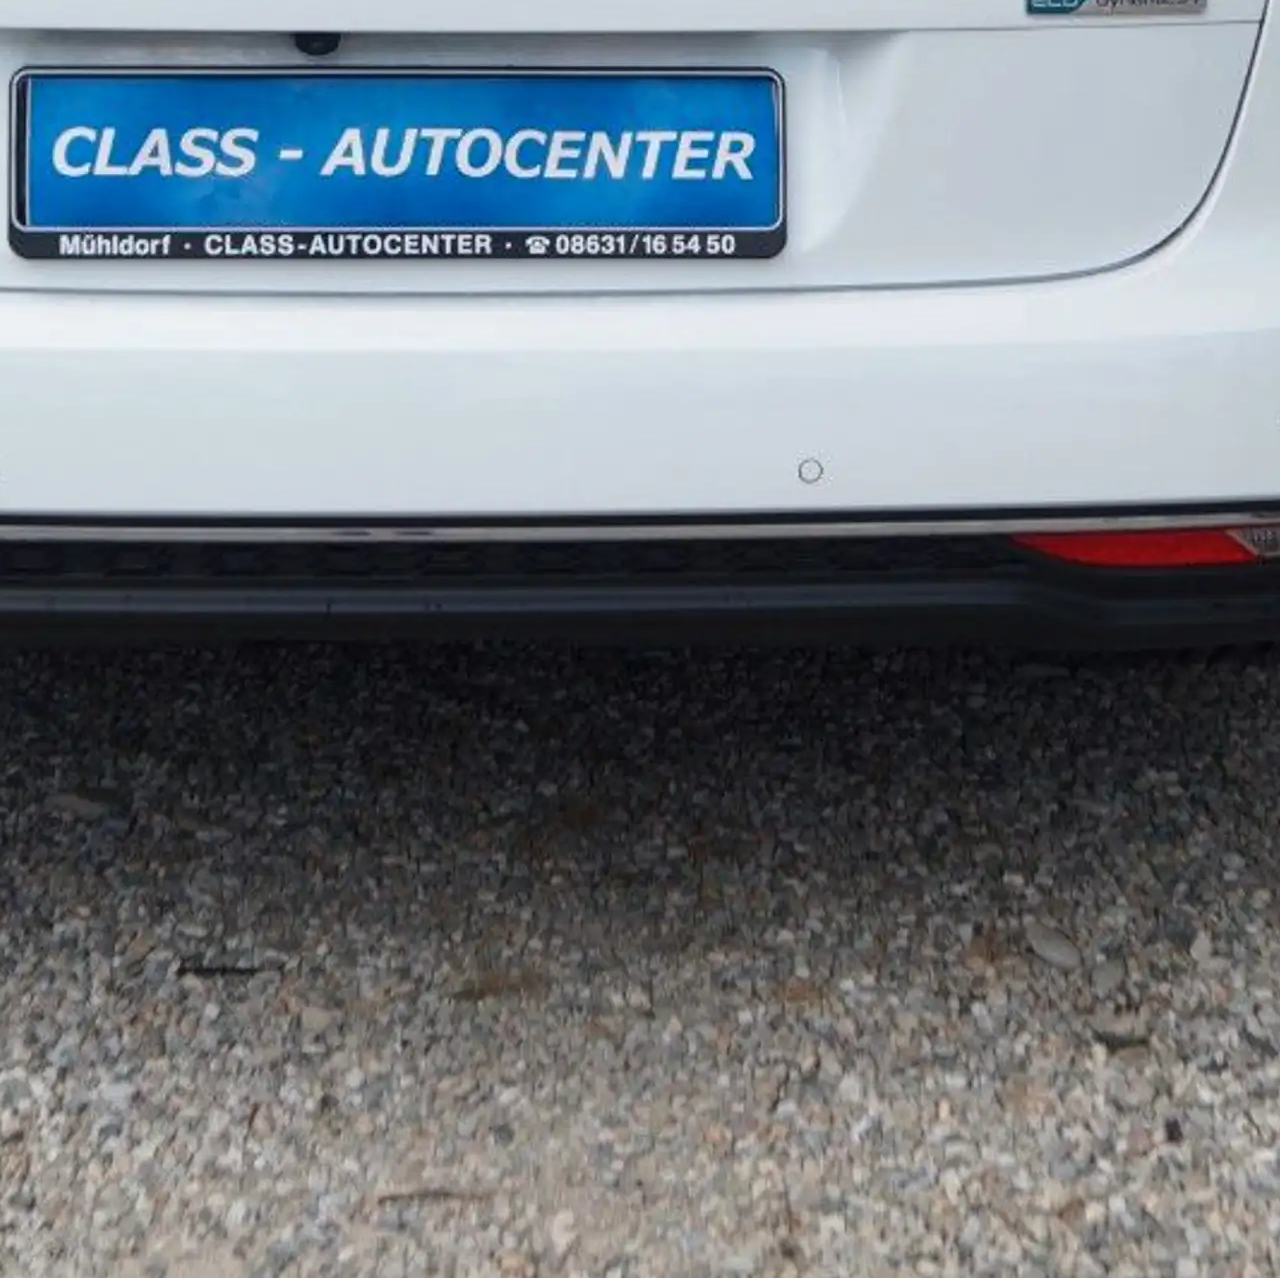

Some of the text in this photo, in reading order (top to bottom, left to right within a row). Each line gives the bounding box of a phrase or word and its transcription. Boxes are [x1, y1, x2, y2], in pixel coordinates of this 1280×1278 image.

[51, 125, 260, 179] CLASS
[319, 126, 757, 181] AUTOCENTER
[58, 232, 172, 256] Mühldorf
[203, 233, 494, 257] CLASS-AUTOCENTER
